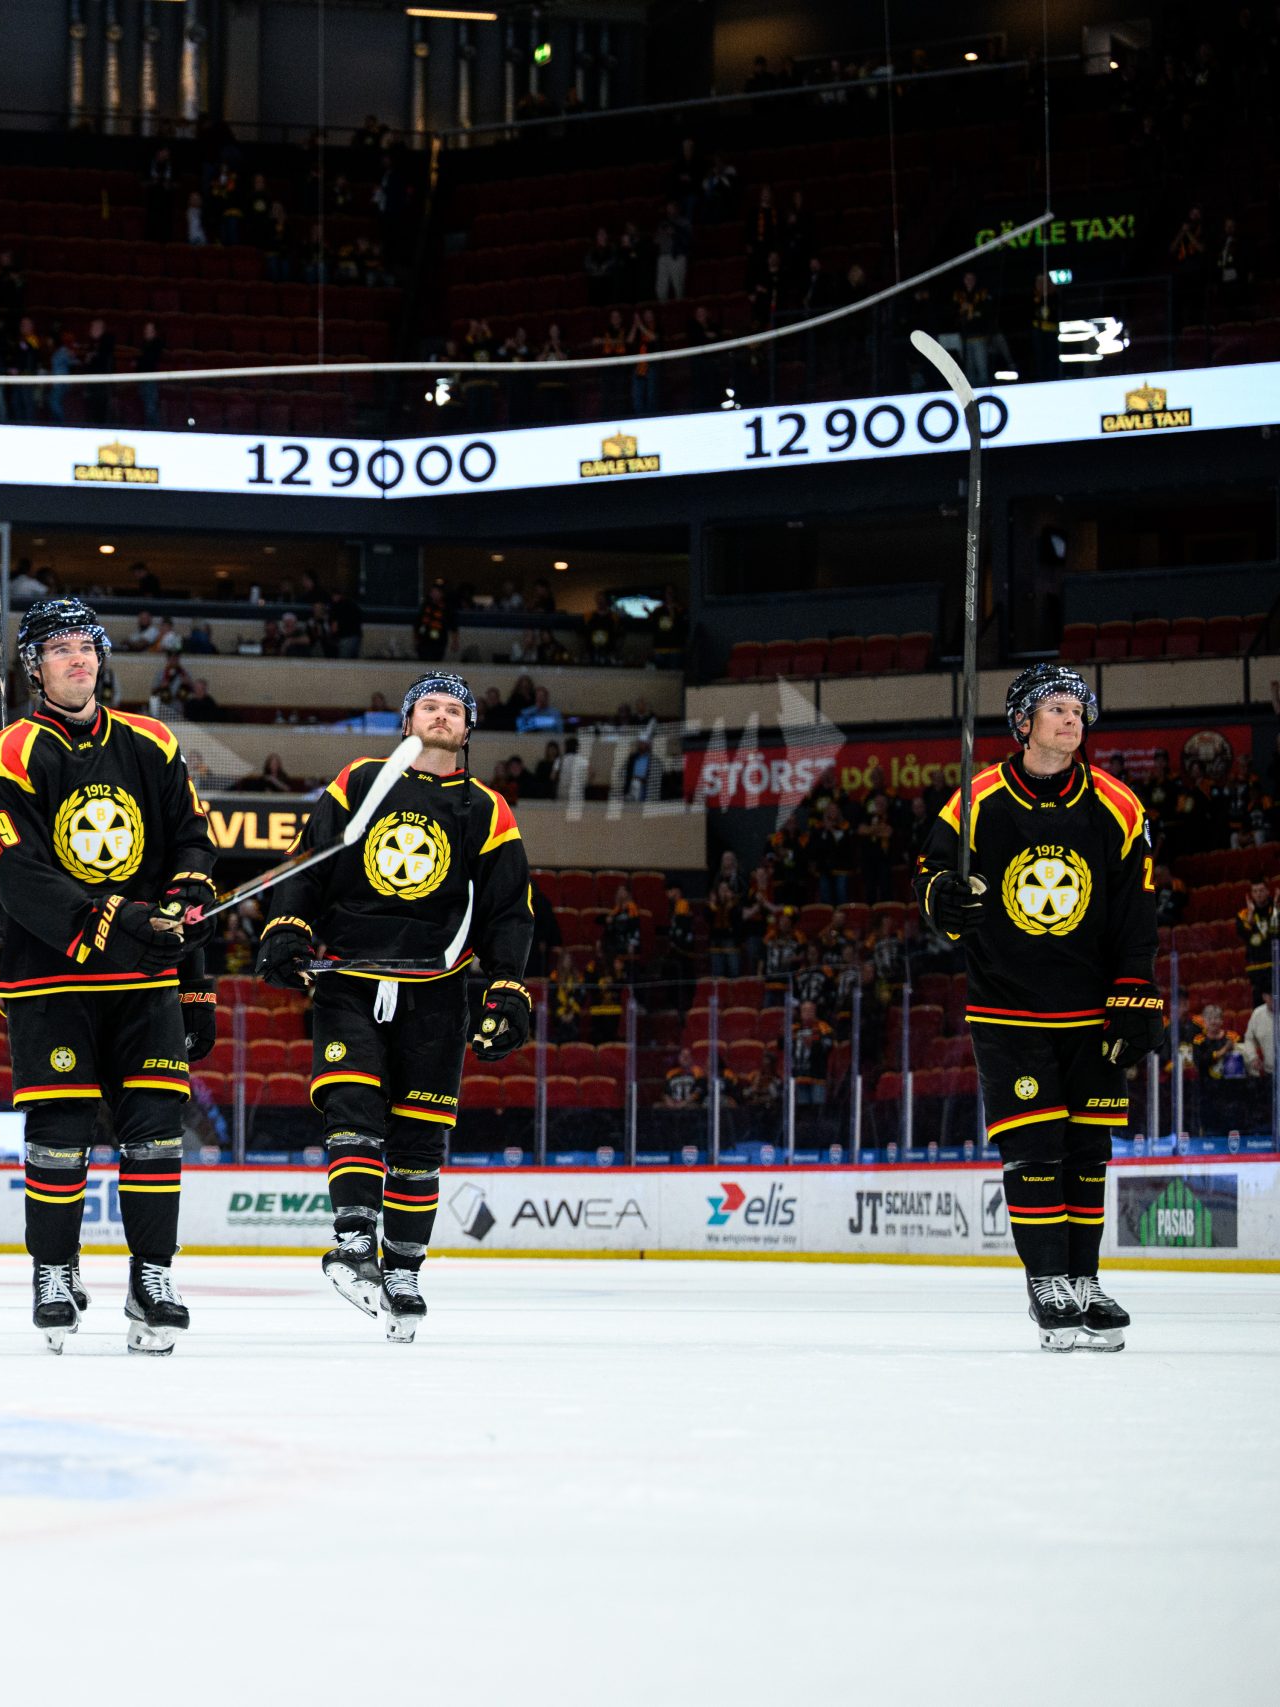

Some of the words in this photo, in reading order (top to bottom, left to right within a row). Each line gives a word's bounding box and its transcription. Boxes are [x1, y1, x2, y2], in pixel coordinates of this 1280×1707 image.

[78, 742, 94, 751] SHL
[417, 773, 435, 783] SHL
[84, 784, 112, 799] 1912
[207, 798, 298, 850] VLE
[401, 811, 428, 827] 1912
[1035, 845, 1064, 858] 1912
[94, 894, 125, 952] BAUE
[1105, 996, 1164, 1010] BAUER
[406, 1090, 459, 1107] BAUER
[1086, 1097, 1129, 1108] BAUE
[744, 1182, 798, 1226] elis
[885, 1191, 932, 1216] SCHAKT
[936, 1191, 952, 1216] AB
[510, 1198, 650, 1230] AWEA
[1157, 1208, 1195, 1237] PASAB
